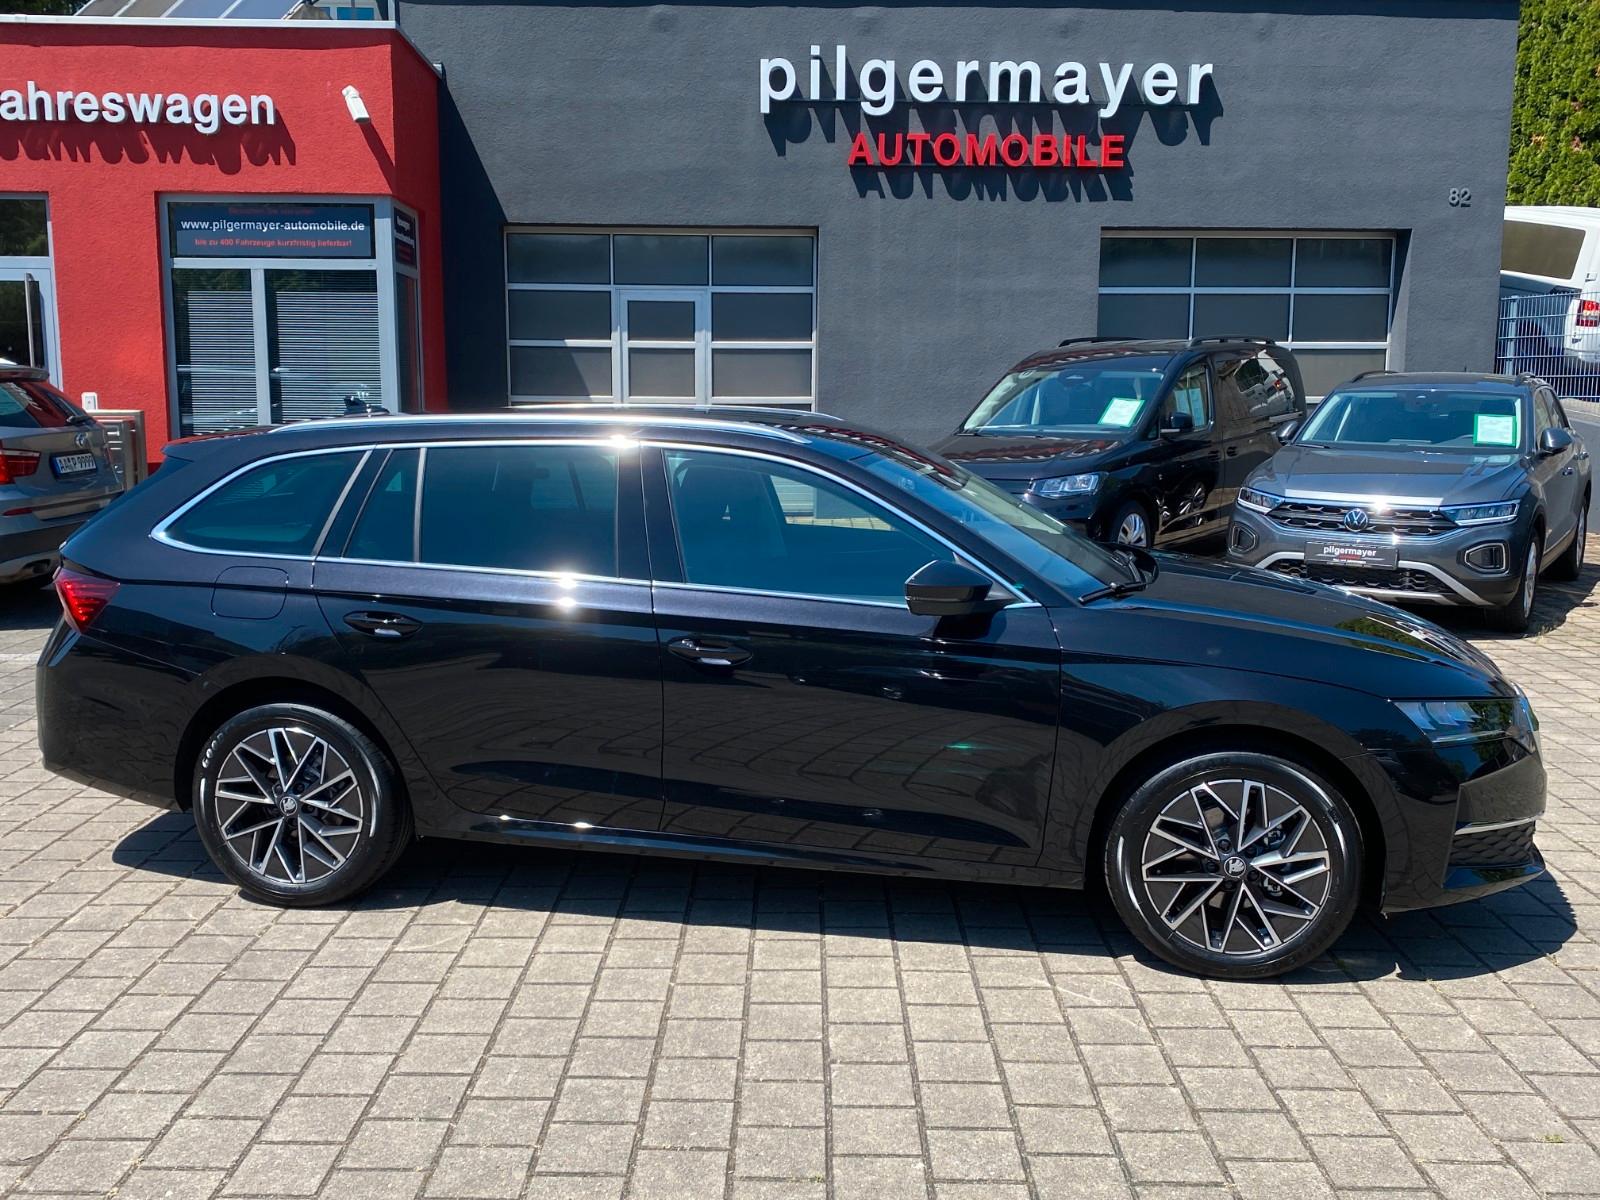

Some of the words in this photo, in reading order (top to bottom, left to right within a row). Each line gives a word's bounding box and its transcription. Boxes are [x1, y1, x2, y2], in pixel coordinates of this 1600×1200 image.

[760, 44, 1213, 117] pilgermayer
[0, 81, 275, 134] ahreswagen
[848, 132, 1125, 168] AUTOMOBILE
[1448, 187, 1472, 207] 82
[180, 219, 365, 232] www.pilgermayer-automobile.de
[235, 239, 276, 248] Fahrzeuge
[1323, 545, 1377, 557] pilgermayer
